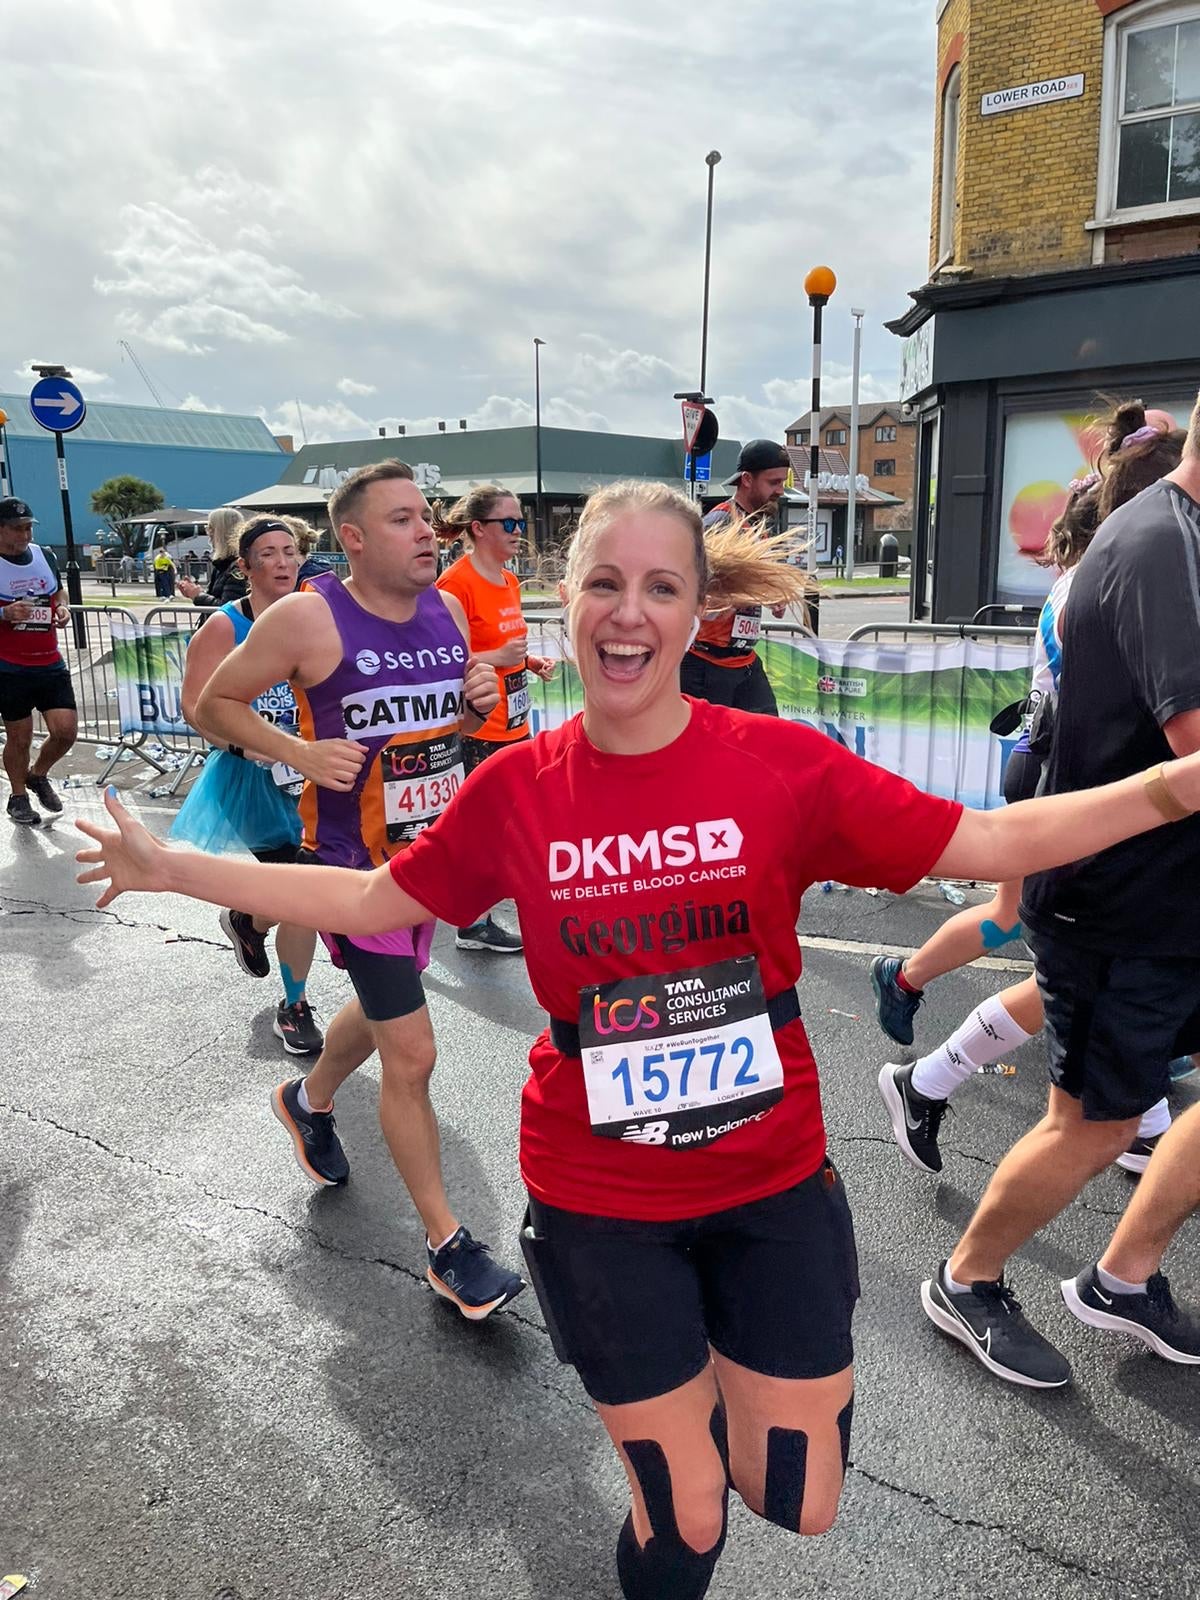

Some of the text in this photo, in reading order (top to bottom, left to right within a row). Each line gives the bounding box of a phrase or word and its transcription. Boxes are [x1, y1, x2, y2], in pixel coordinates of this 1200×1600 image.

[986, 88, 1029, 107] LOWER
[1031, 81, 1067, 97] ROAD
[685, 408, 699, 421] GIVE
[383, 645, 465, 670] sense
[136, 684, 183, 724] BU
[256, 692, 296, 710] NOIS
[781, 704, 866, 721] MINERAL WATER
[429, 743, 446, 754] TATA
[391, 751, 428, 777] tcs
[398, 773, 460, 813] 41330
[548, 825, 697, 883] DKMS
[550, 864, 747, 901] WE DELETE BLOOD CANCER
[559, 899, 751, 957] Georgina
[664, 978, 706, 996] TATA
[666, 979, 752, 1011] CONSULTANCY
[593, 993, 661, 1035] tcs
[668, 1003, 727, 1026] SERVICES
[666, 1034, 720, 1048] #WeRunTogether
[611, 1036, 761, 1106] 15772
[717, 1092, 739, 1102] LORRY
[632, 1109, 653, 1117] WAVE
[671, 1130, 704, 1146] new
